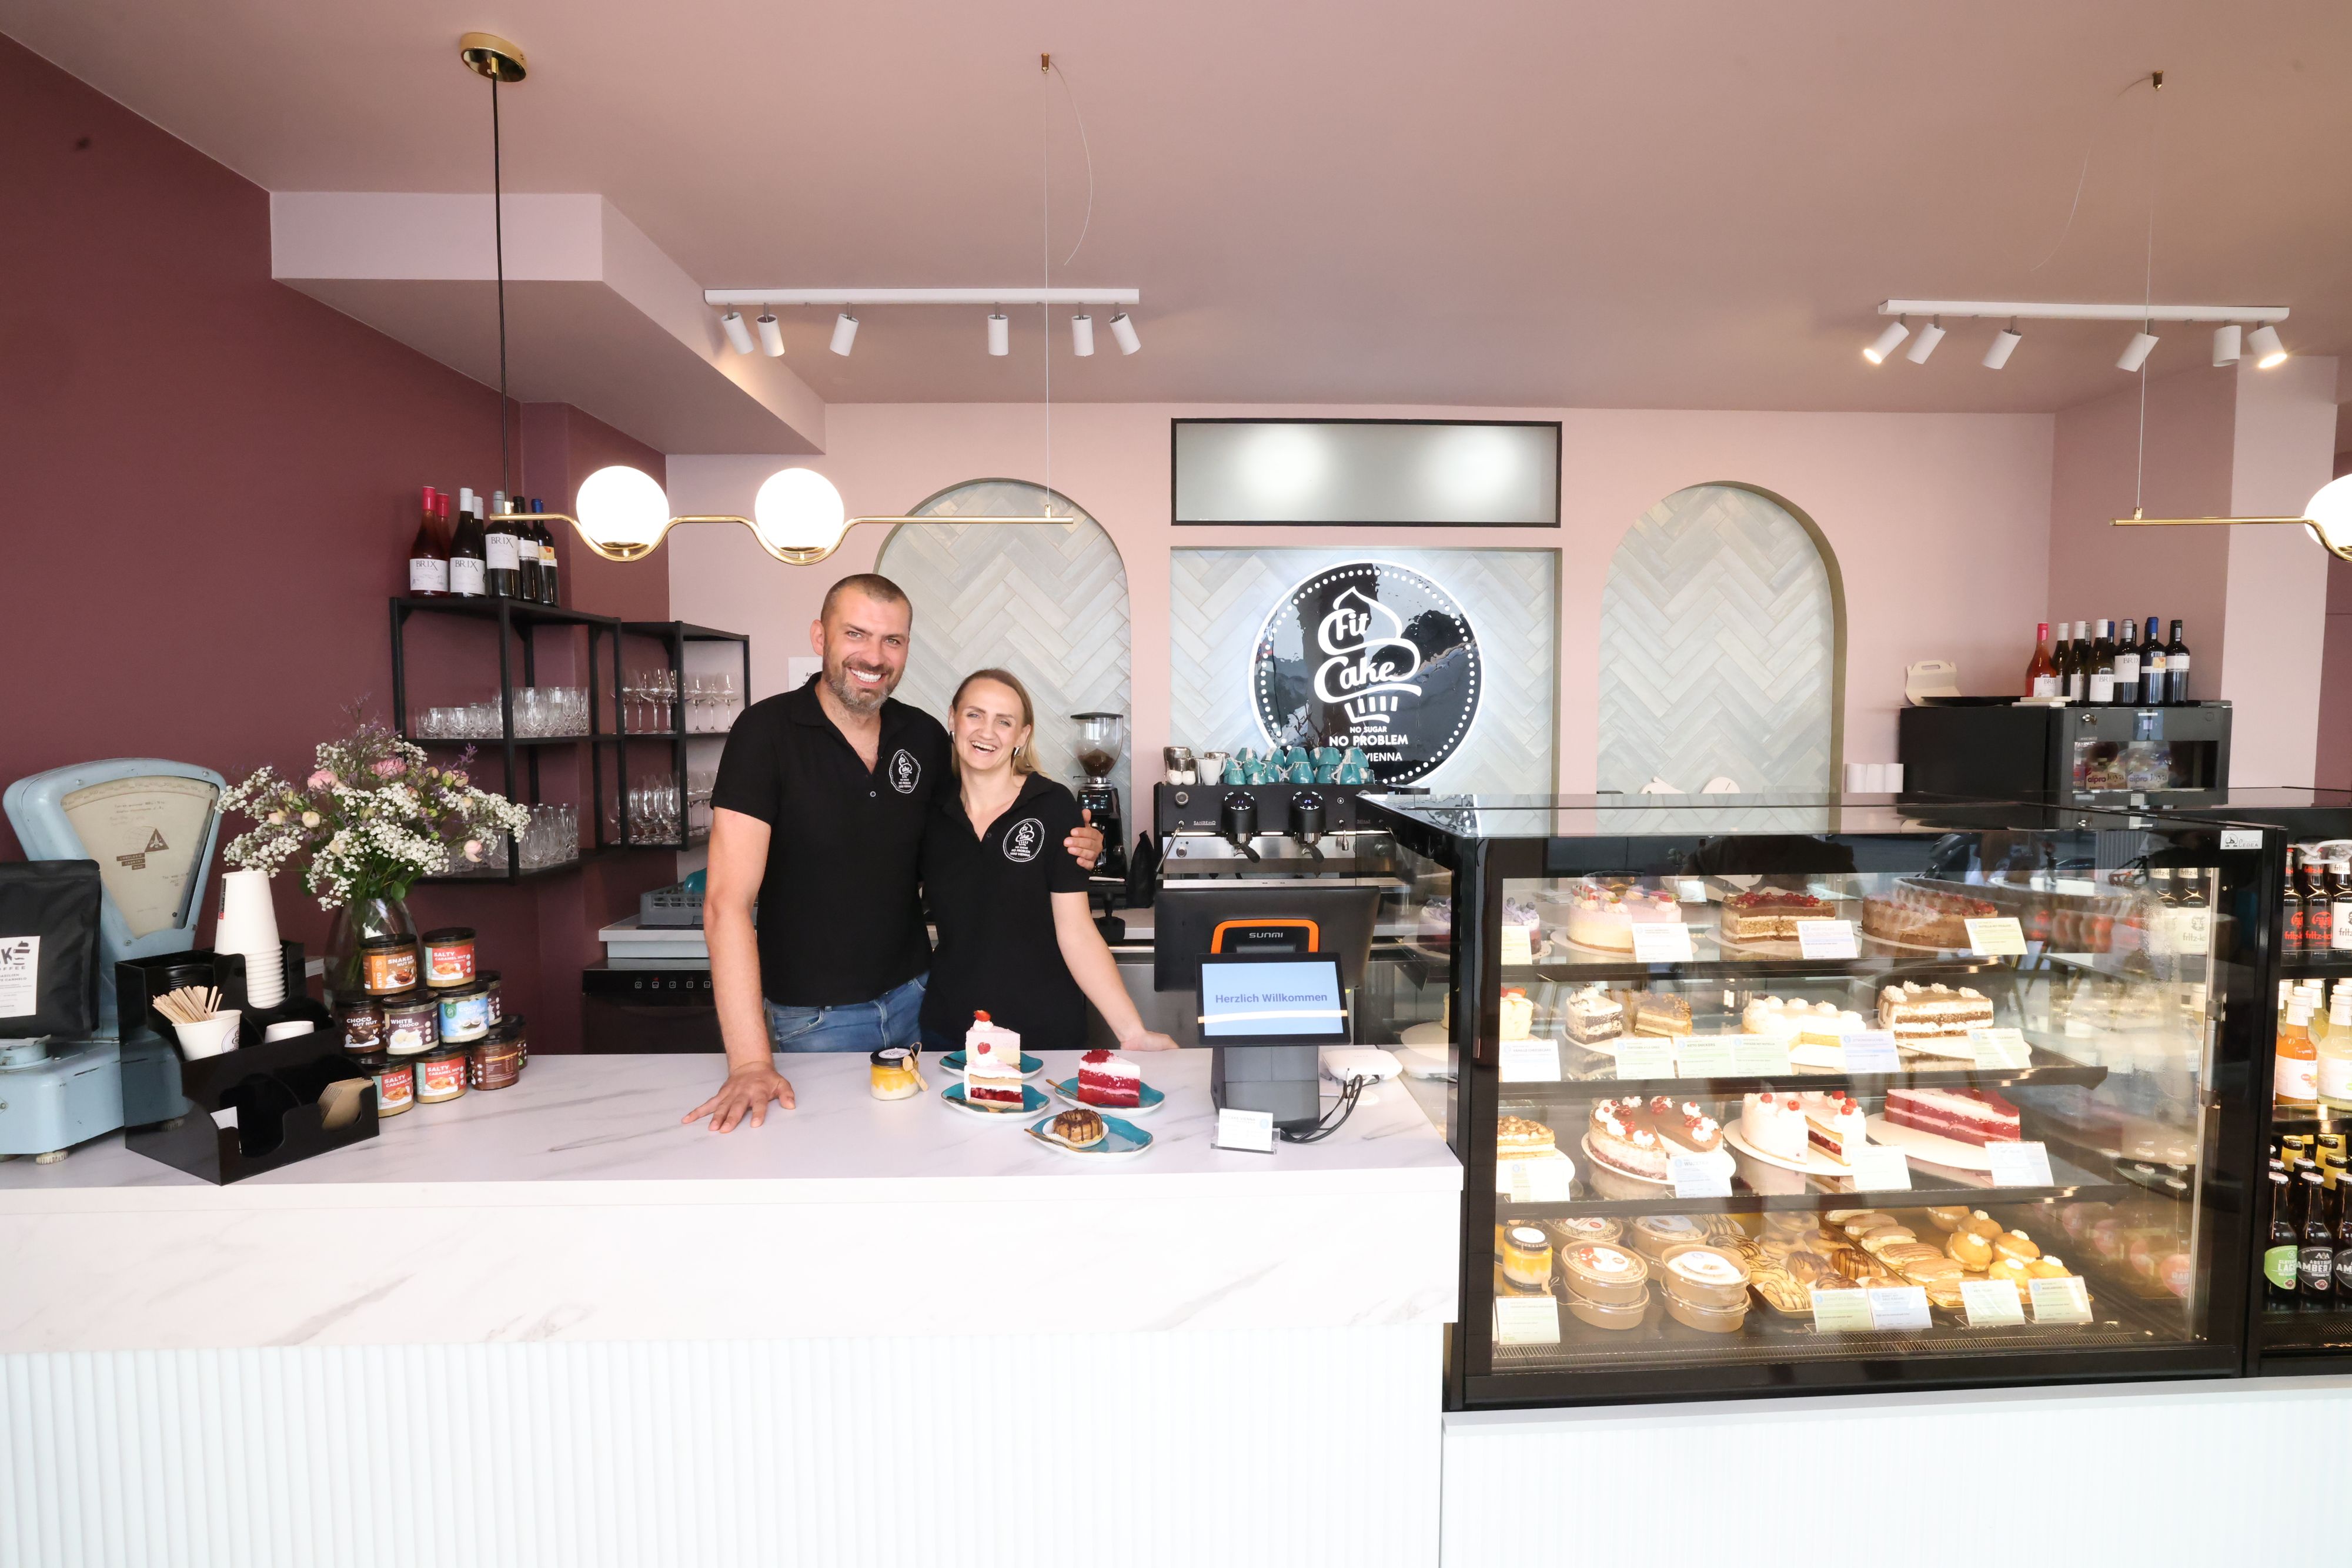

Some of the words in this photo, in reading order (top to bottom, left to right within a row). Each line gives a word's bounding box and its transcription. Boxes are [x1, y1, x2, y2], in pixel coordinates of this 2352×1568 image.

[490, 536, 513, 548] BRIX
[416, 560, 438, 571] BRIX
[455, 560, 478, 571] BRIX
[1329, 735, 1349, 747] NO
[1353, 734, 1409, 746] PROBLEM
[1215, 994, 1259, 1003] Herzlich
[1262, 992, 1328, 1002] Willkommen
[385, 1074, 406, 1084] SALTY
[386, 1080, 407, 1088] CARAMEL
[2296, 1261, 2328, 1272] AMBER
